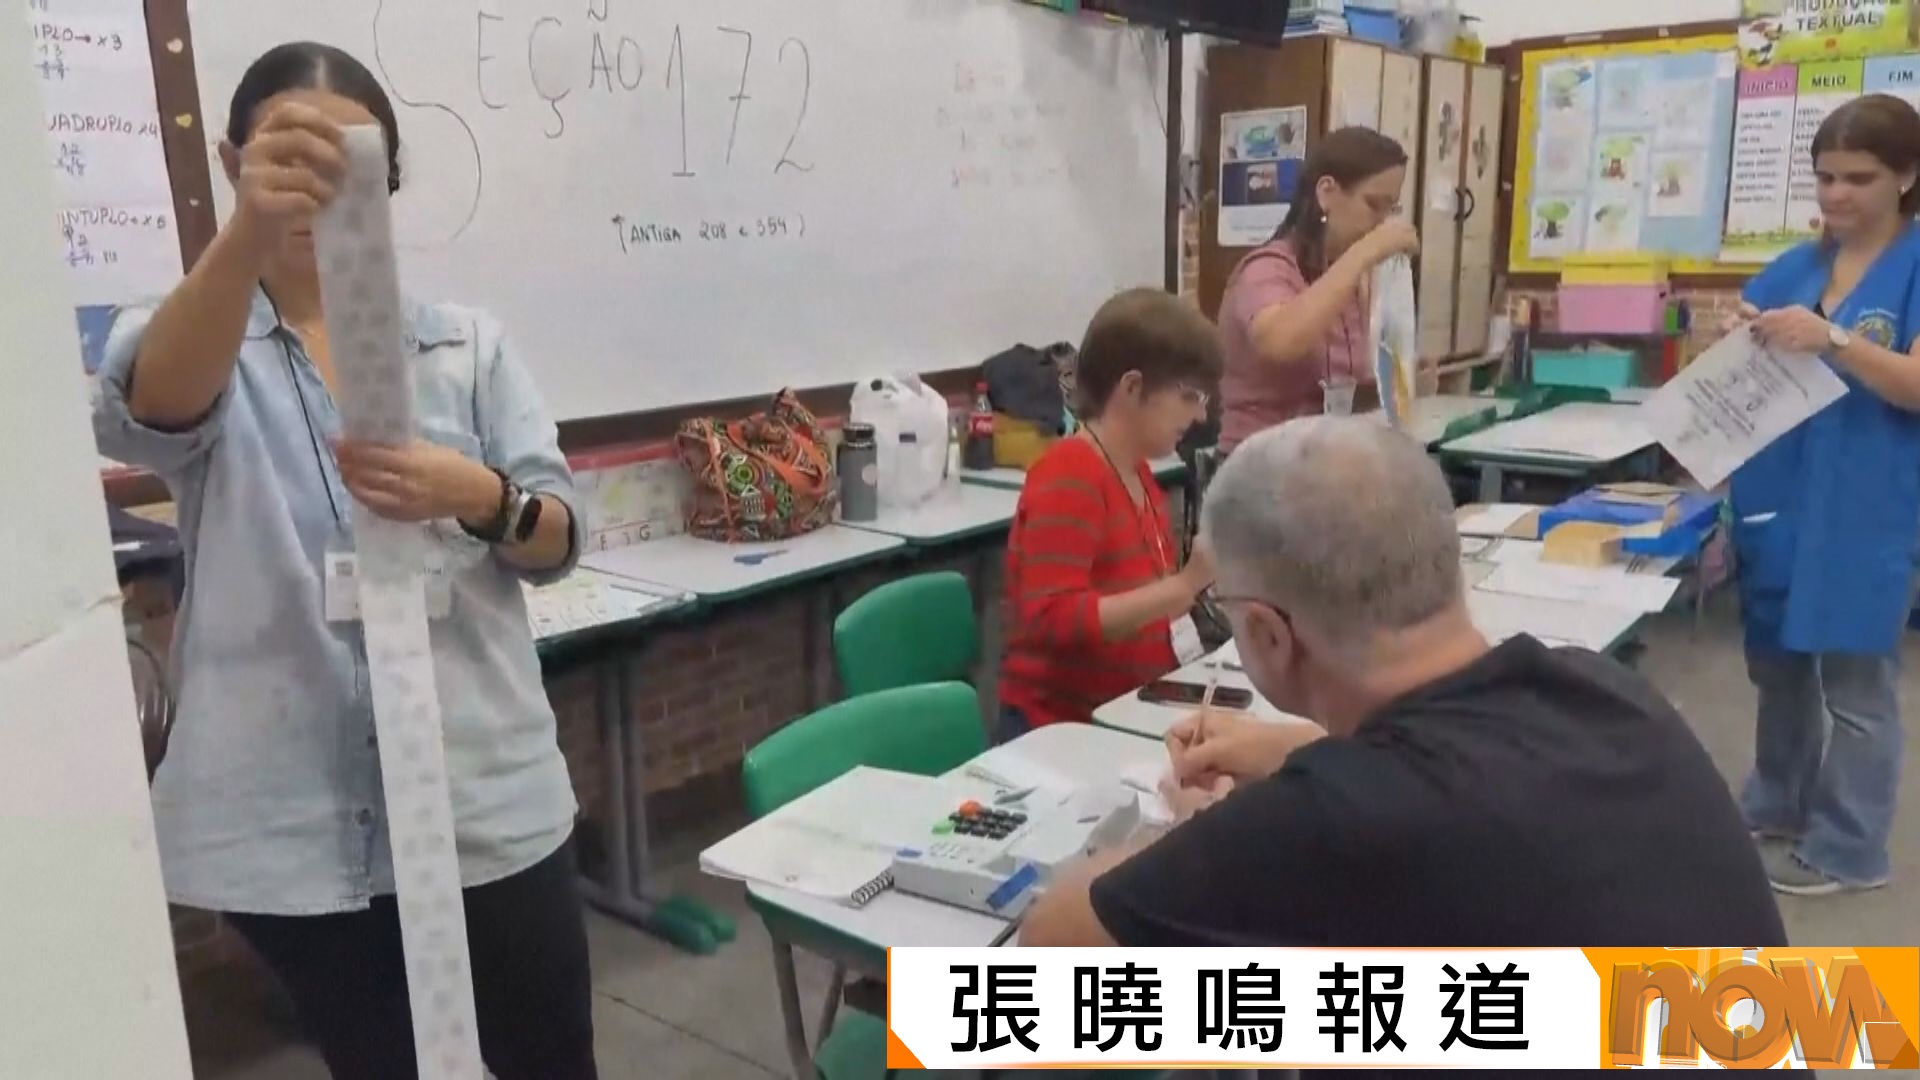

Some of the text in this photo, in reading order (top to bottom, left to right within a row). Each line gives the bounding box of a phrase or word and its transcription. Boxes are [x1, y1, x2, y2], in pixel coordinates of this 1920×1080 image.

[1796, 12, 1876, 31] TEXTUAL
[1811, 75, 1847, 88] MEIO
[1888, 70, 1914, 83] FIM
[667, 24, 815, 177] 172
[698, 220, 728, 241] 208
